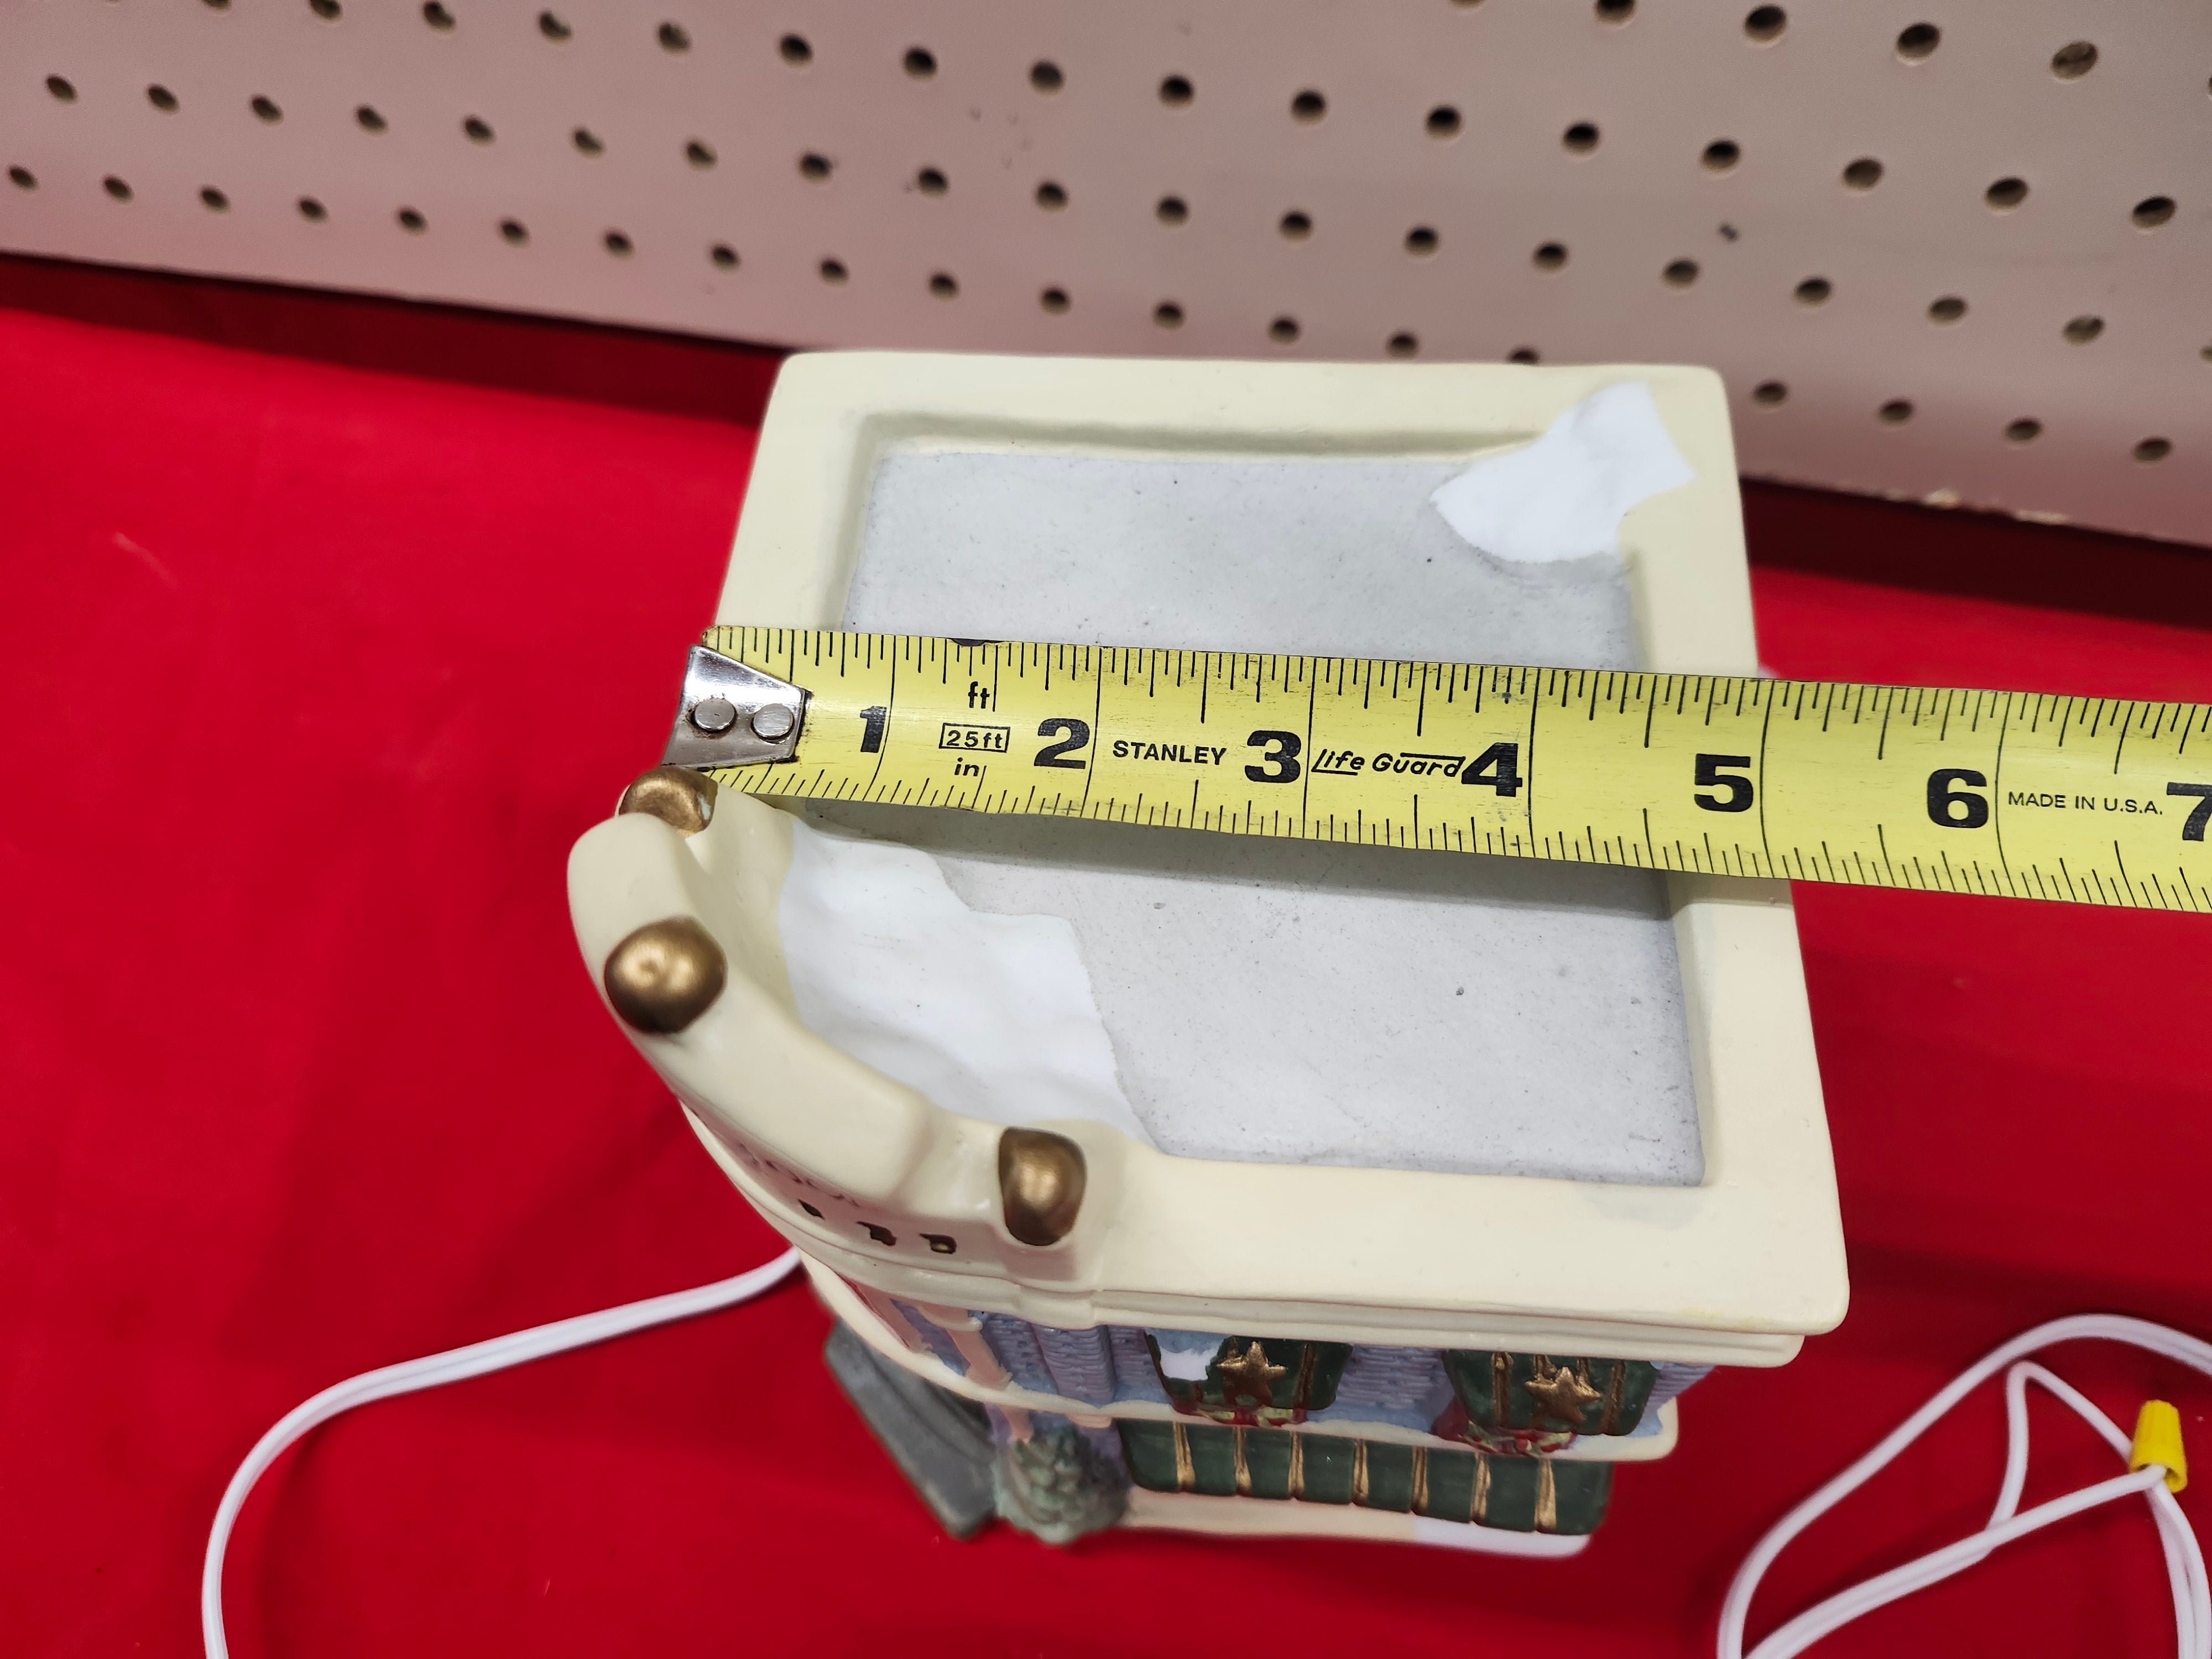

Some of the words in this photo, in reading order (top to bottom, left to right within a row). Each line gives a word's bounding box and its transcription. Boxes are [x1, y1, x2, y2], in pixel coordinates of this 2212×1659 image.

[968, 681, 990, 709] ft
[860, 706, 887, 753] 1
[946, 730, 1003, 749] 25ft
[1034, 718, 1090, 769] 2
[1113, 740, 1227, 765] STANLEY
[954, 757, 979, 777] in
[1244, 730, 1302, 784] 3
[1311, 749, 1365, 776] Life
[1372, 752, 1467, 778] Guard
[1461, 742, 1523, 797] 4
[1694, 753, 1754, 812] 5
[1927, 768, 1989, 828] 6
[2008, 791, 2067, 808] MADE
[2075, 795, 2095, 810] IN
[2104, 797, 2163, 815] U.S.A.
[2166, 781, 2212, 842] 7
